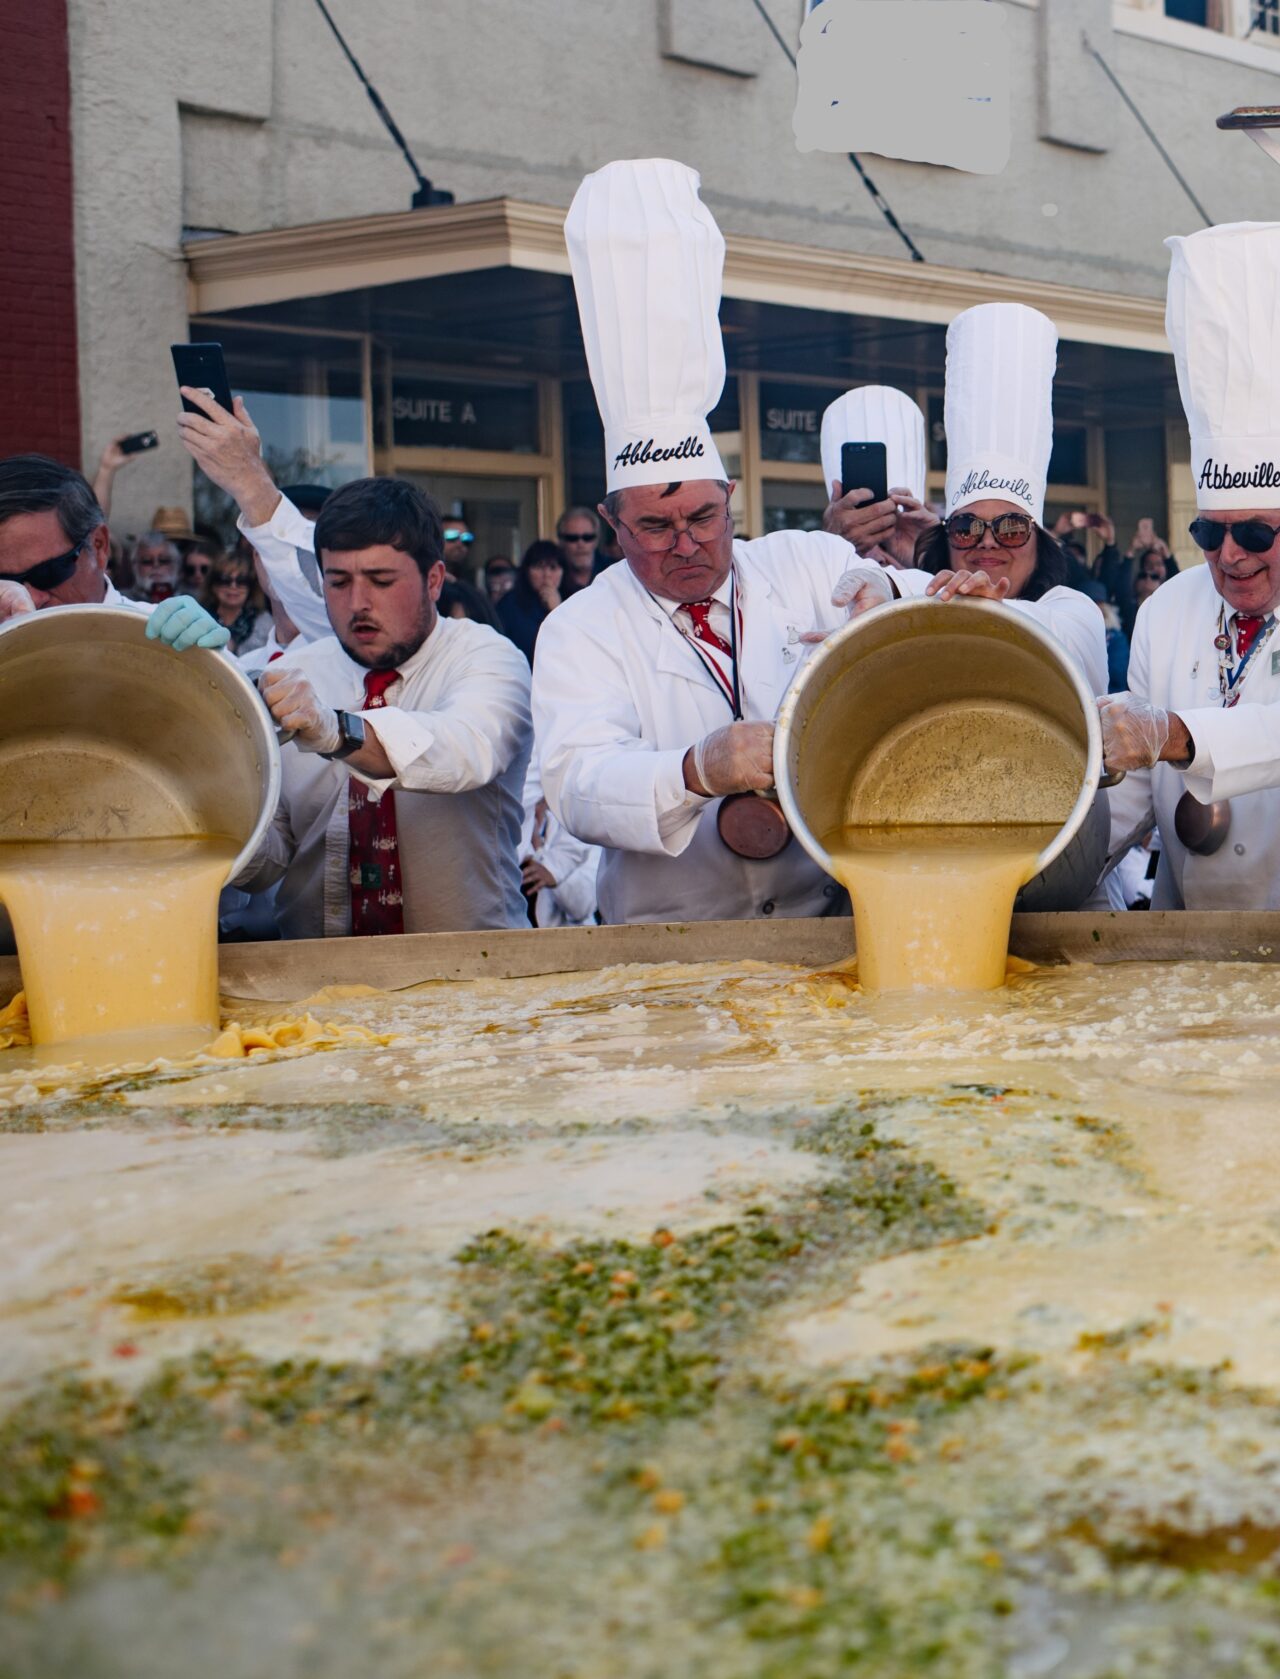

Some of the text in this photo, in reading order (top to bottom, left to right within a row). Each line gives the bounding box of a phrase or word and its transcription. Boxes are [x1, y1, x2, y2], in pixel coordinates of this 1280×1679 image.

[394, 397, 477, 425] SUITE A
[767, 408, 817, 432] SUITE
[613, 435, 704, 471] Abbeville
[951, 468, 1034, 506] Abbeville
